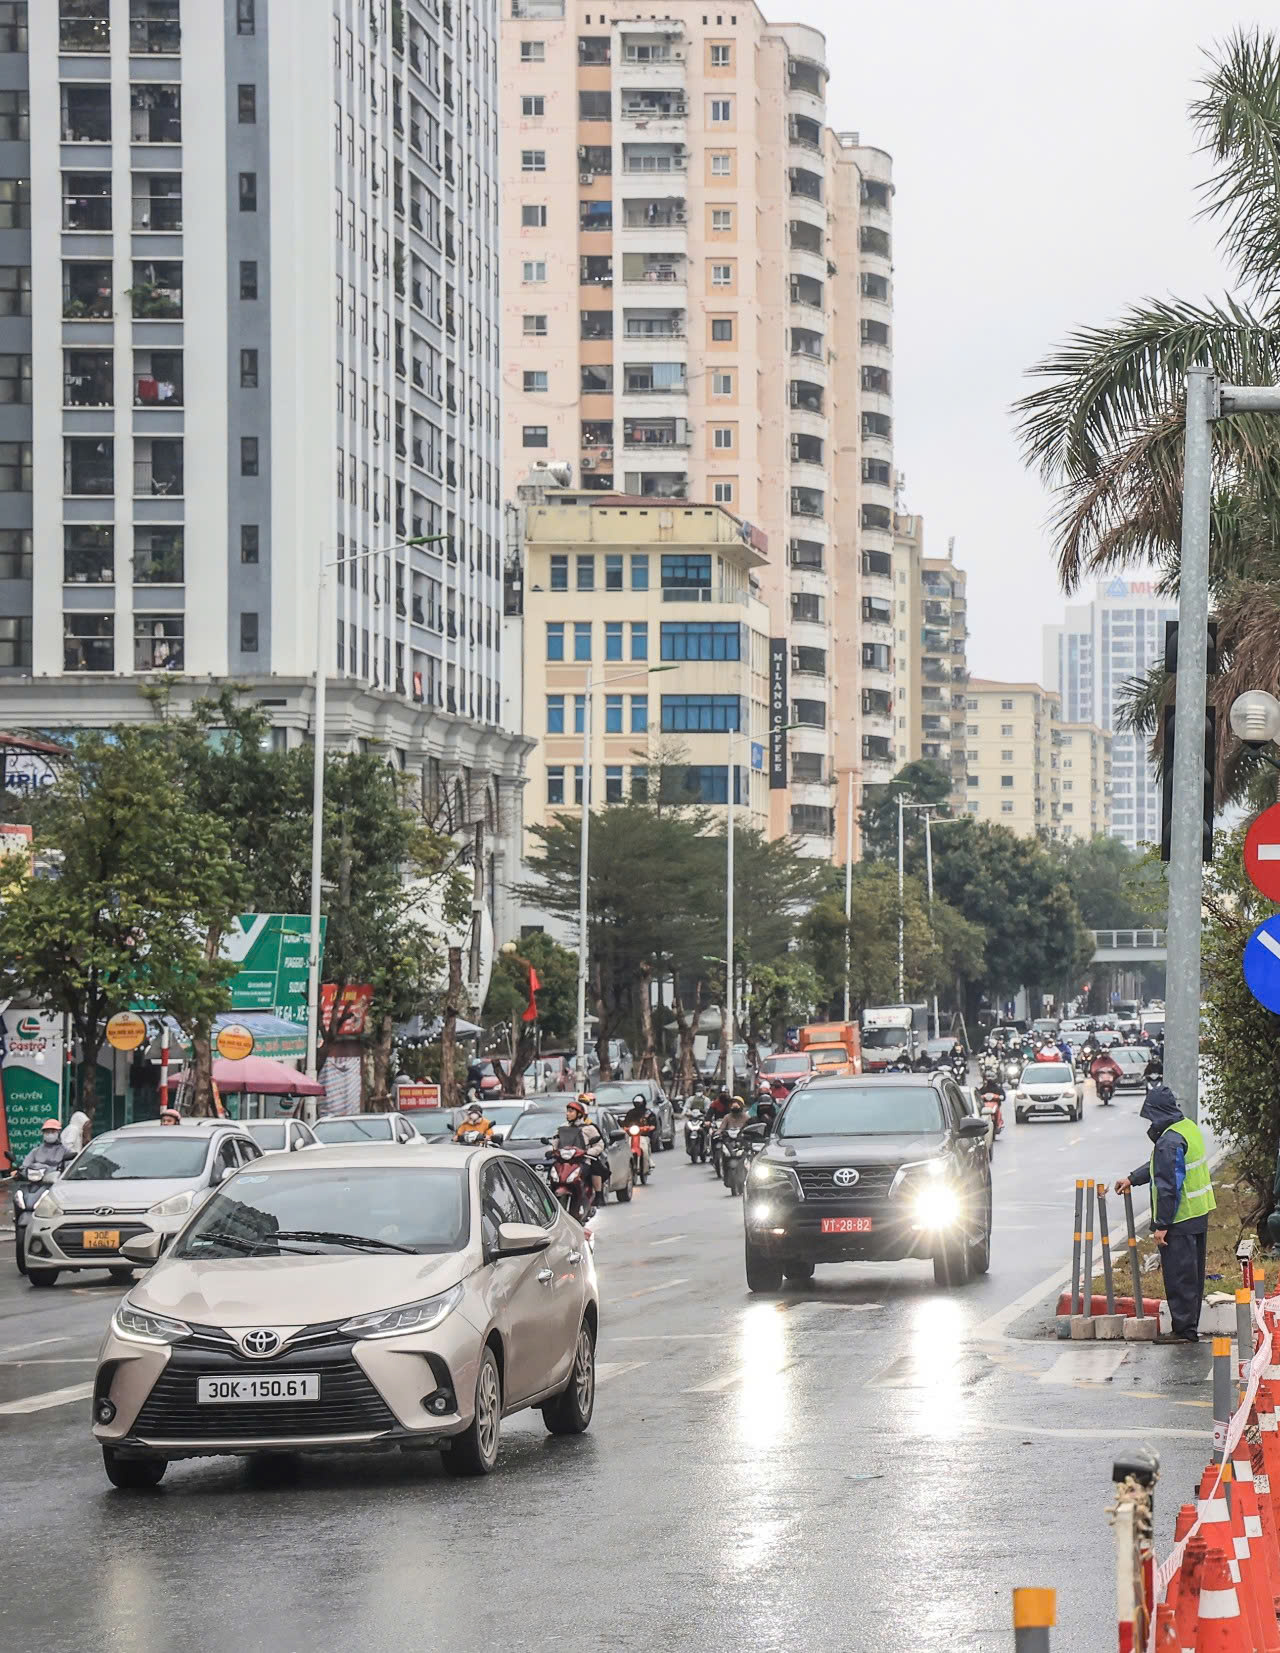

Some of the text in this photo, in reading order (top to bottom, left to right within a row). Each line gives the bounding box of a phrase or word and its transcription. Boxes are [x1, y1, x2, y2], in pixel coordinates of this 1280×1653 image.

[773, 652, 784, 772] MILANO COFFEE
[10, 1091, 43, 1100] CHUYÊN
[12, 1104, 24, 1112] GA
[29, 1104, 39, 1112] XE
[823, 1218, 870, 1231] VT-28-82
[208, 1379, 308, 1399] 30K-150.61
